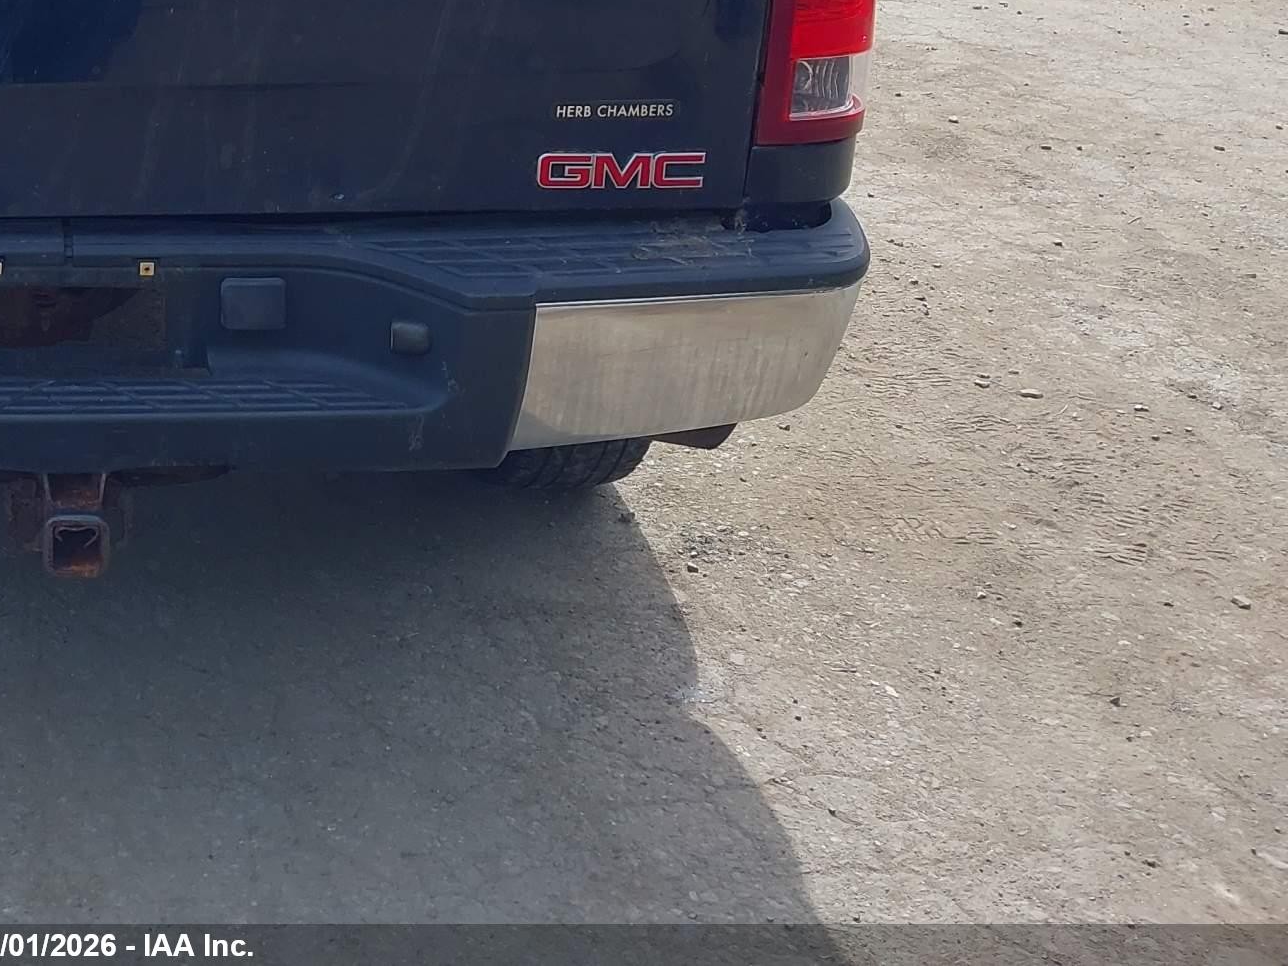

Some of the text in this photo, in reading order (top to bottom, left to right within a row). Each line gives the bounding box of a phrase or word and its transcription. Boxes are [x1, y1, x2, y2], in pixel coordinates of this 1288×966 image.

[556, 104, 674, 118] HERB CHAMBERS
[537, 152, 707, 190] GMC
